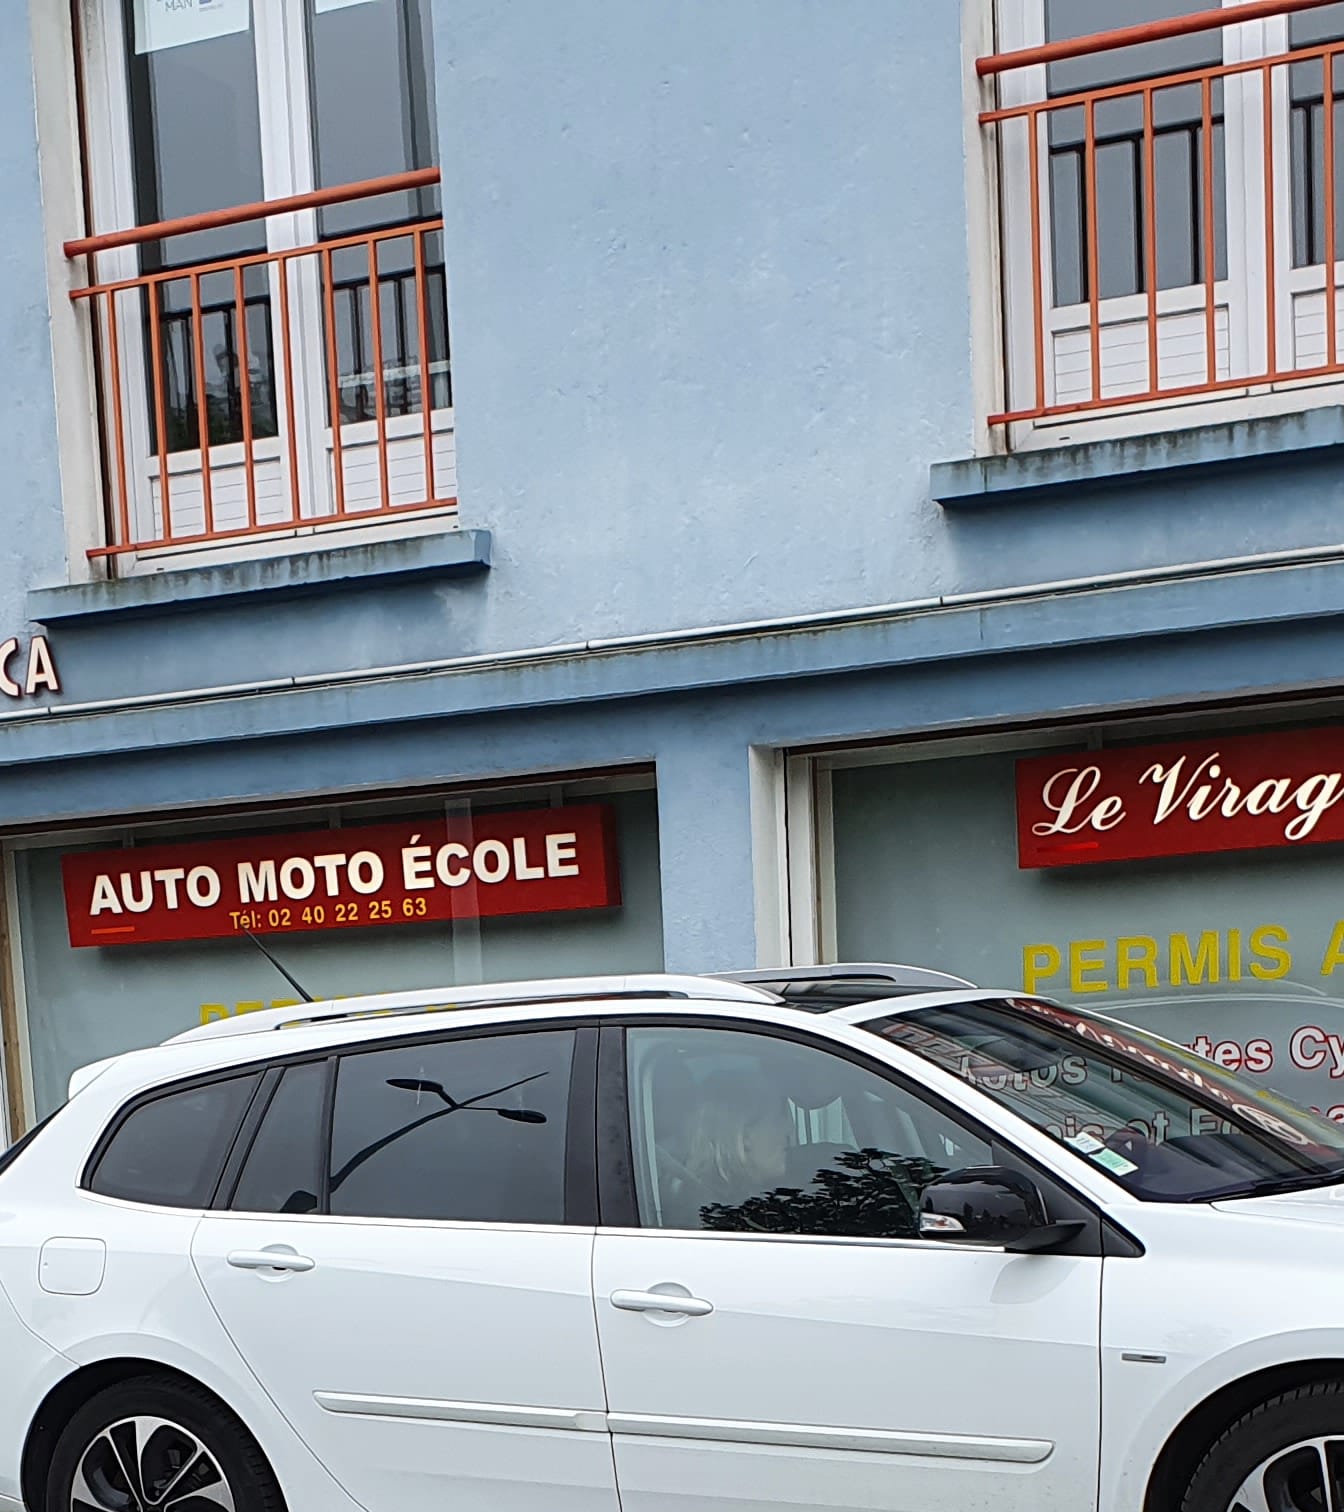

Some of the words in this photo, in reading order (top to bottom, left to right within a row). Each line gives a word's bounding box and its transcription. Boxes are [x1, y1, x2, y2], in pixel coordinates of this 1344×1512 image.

[1031, 766, 1126, 836] Le
[89, 865, 221, 916] AUTO
[237, 850, 384, 904] MOTO
[401, 832, 580, 890] ÉCOLE
[229, 910, 262, 930] Tél:
[268, 907, 291, 928] 02
[301, 905, 325, 926] 40
[335, 902, 359, 923] 22
[369, 900, 393, 921] 25
[403, 897, 427, 918] 63
[1021, 924, 1292, 995] PERMIS
